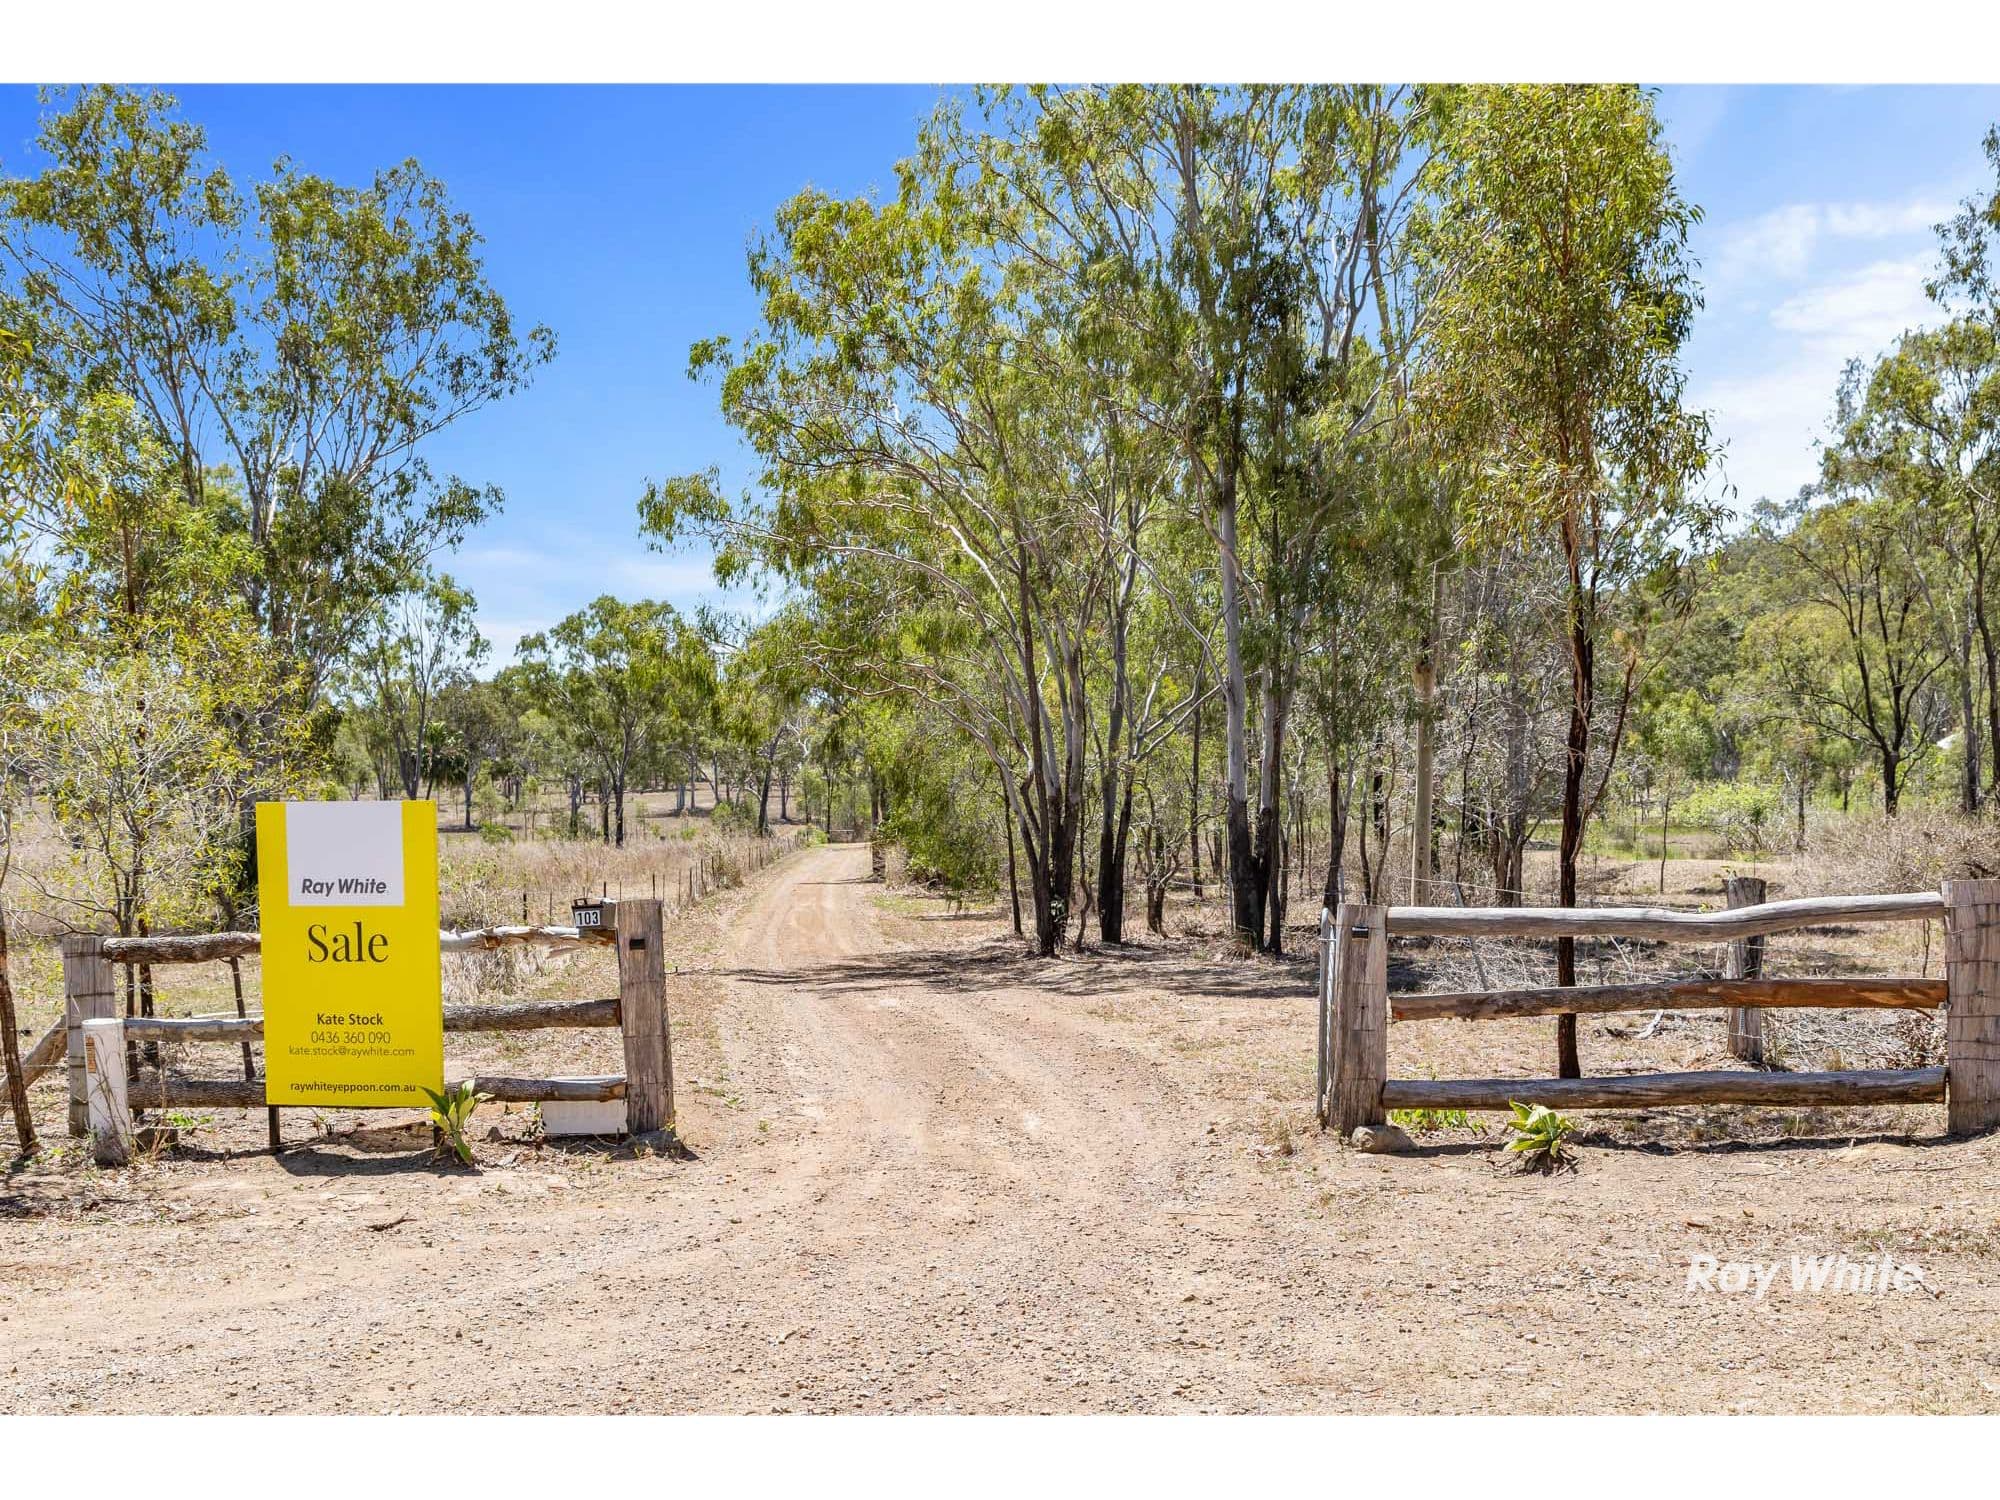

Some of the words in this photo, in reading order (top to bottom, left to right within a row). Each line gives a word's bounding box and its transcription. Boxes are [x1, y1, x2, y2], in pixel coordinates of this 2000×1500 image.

[301, 878, 334, 897] Ray
[338, 878, 387, 894] White
[577, 911, 599, 925] 103
[307, 921, 389, 963] Sale
[317, 1013, 345, 1025] Kate
[348, 1013, 383, 1025] Stock
[311, 1031, 340, 1044] 0436
[343, 1031, 365, 1044] 360
[368, 1031, 391, 1044] 090
[288, 1045, 415, 1058] kate.stock@raywhite.com
[290, 1081, 416, 1094] raywhiteyeppoon.com.au
